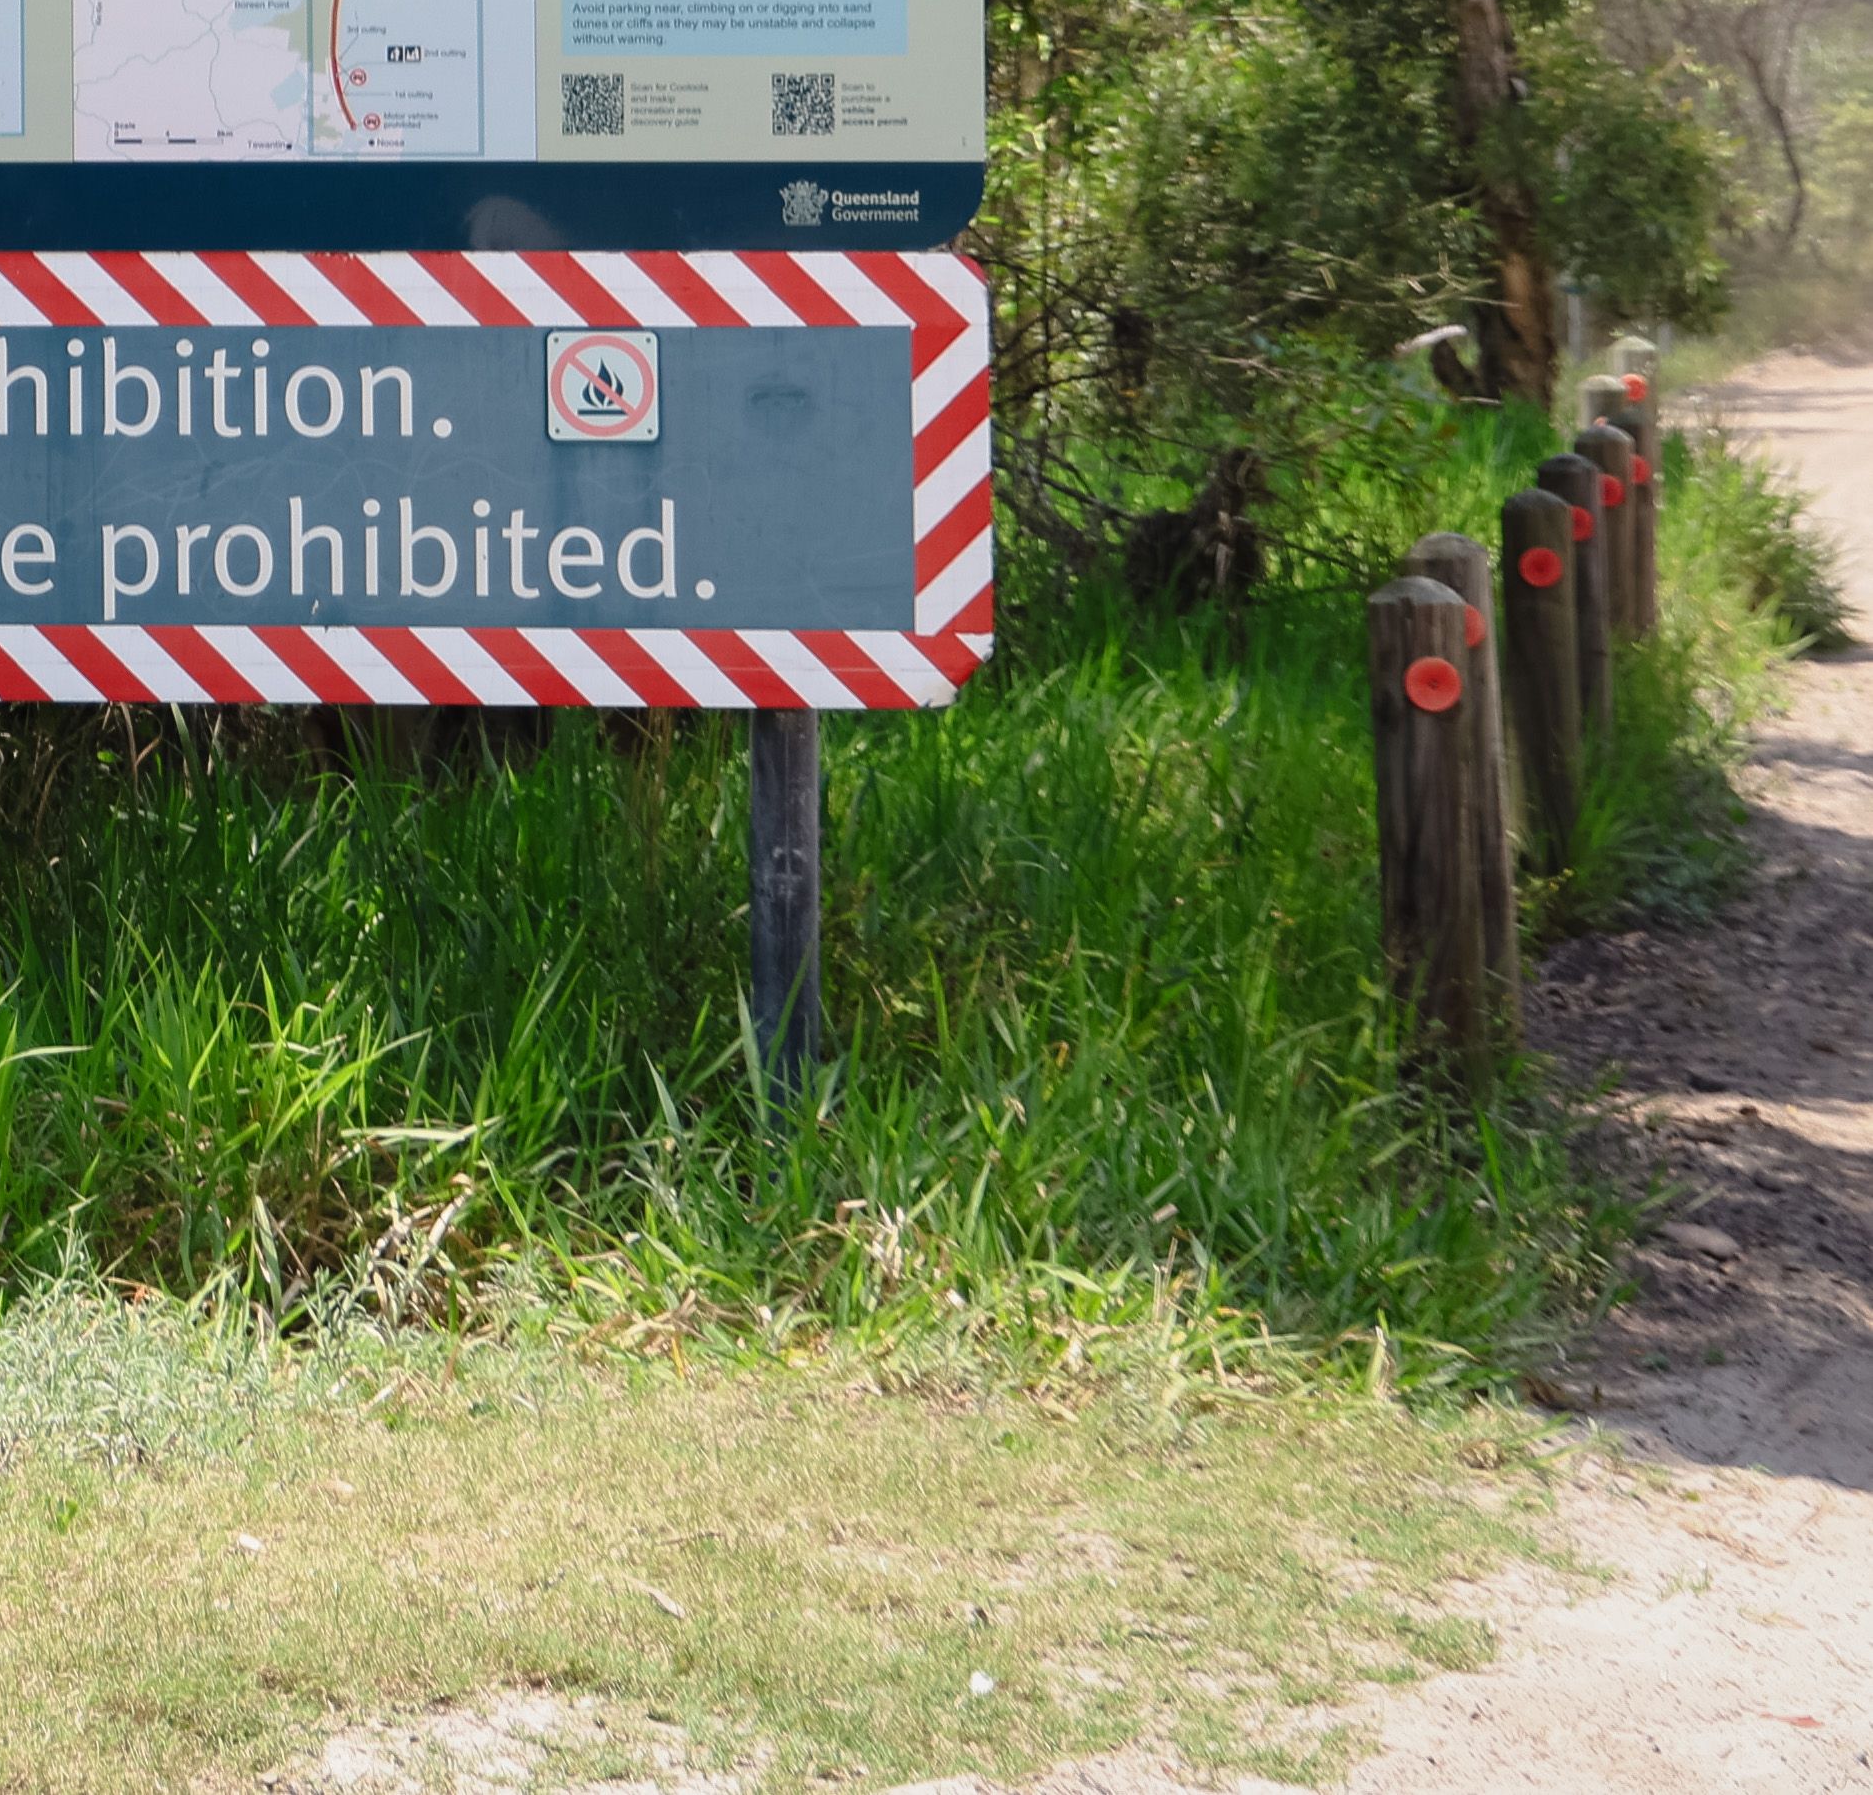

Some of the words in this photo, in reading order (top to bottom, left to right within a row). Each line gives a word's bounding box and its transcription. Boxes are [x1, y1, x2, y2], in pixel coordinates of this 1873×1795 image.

[831, 190, 918, 209] Queensland
[831, 208, 917, 221] Government
[103, 500, 714, 619] prohibited.
